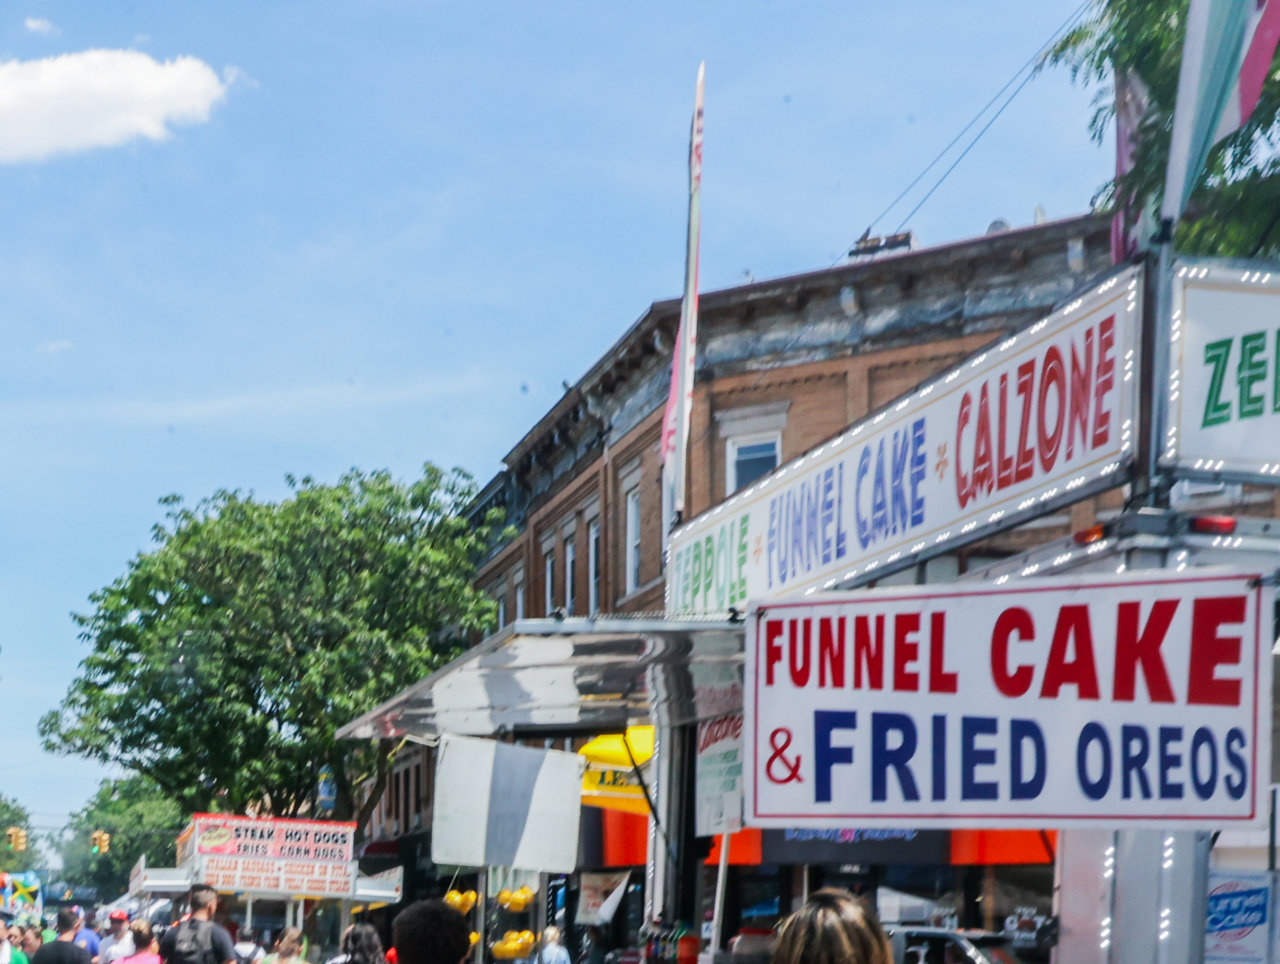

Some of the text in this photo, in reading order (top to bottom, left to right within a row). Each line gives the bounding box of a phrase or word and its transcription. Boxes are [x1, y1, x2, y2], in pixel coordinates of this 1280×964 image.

[1200, 327, 1280, 430] ZE
[767, 460, 847, 589] FUNNEL
[855, 416, 927, 551] CAKE
[955, 312, 1117, 510] CALZONE
[765, 595, 1248, 707] FUNNEL CAKE
[765, 727, 804, 786] &
[813, 709, 1047, 803] FRIED
[1076, 720, 1248, 801] OREOS
[284, 829, 310, 843] HOT
